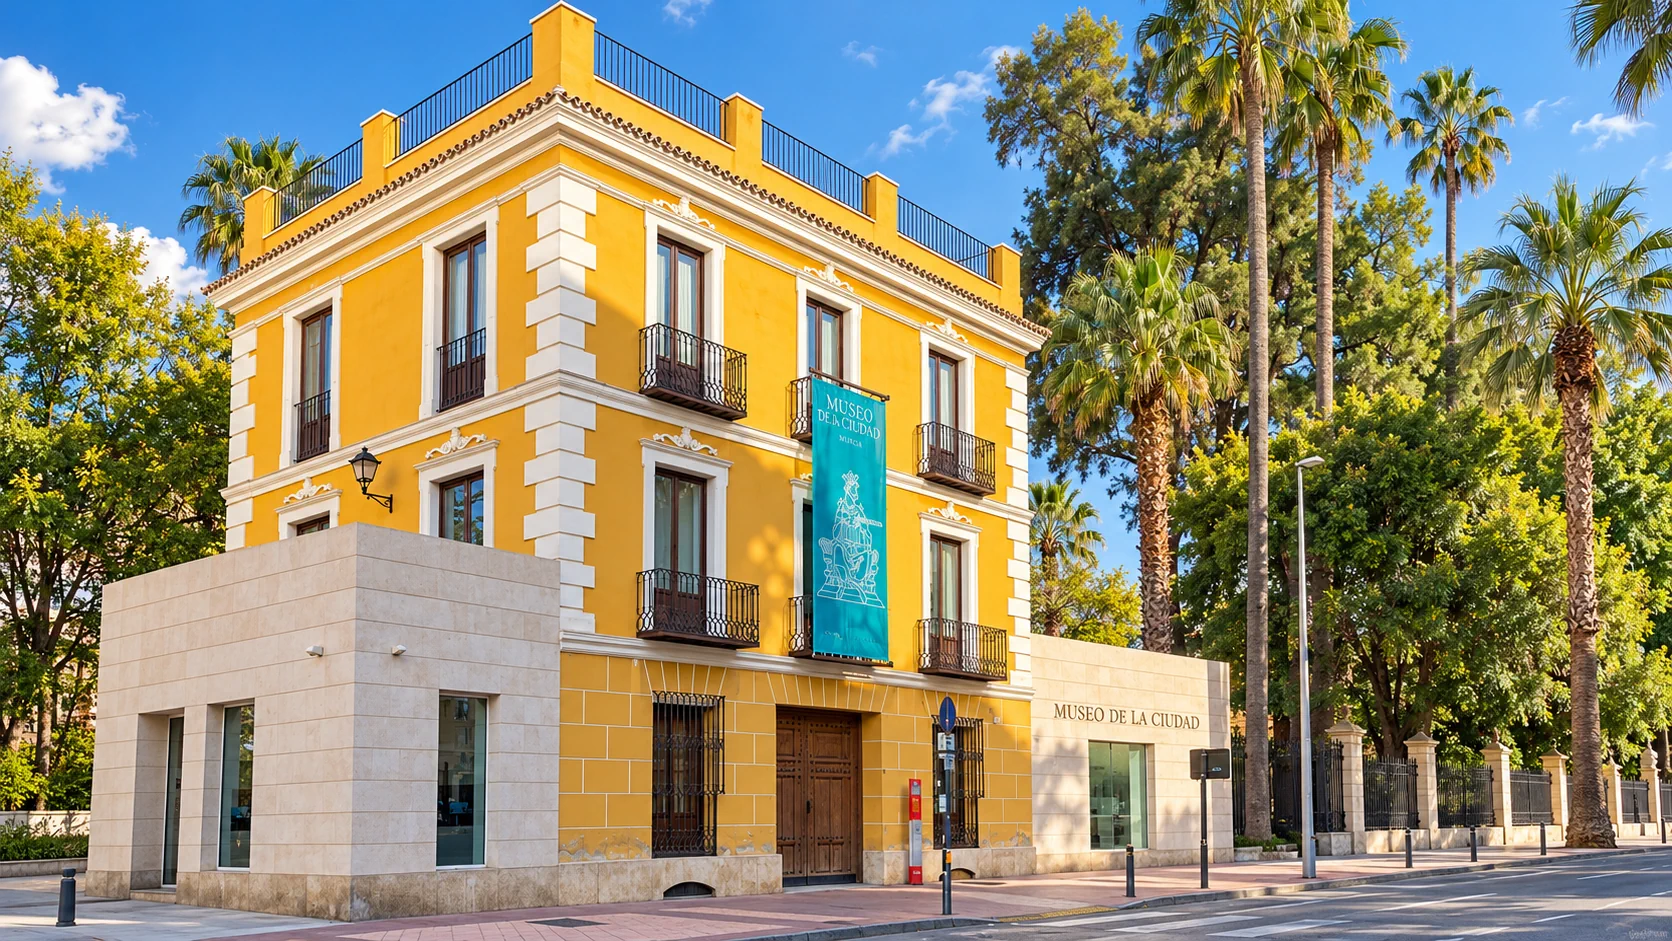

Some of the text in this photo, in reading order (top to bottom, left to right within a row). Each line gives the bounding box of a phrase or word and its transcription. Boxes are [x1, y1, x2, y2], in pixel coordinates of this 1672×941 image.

[827, 394, 873, 424] MUSEO
[842, 417, 881, 440] CIUDAD
[1054, 703, 1200, 730] MUSEO DE LA CIUDAD
